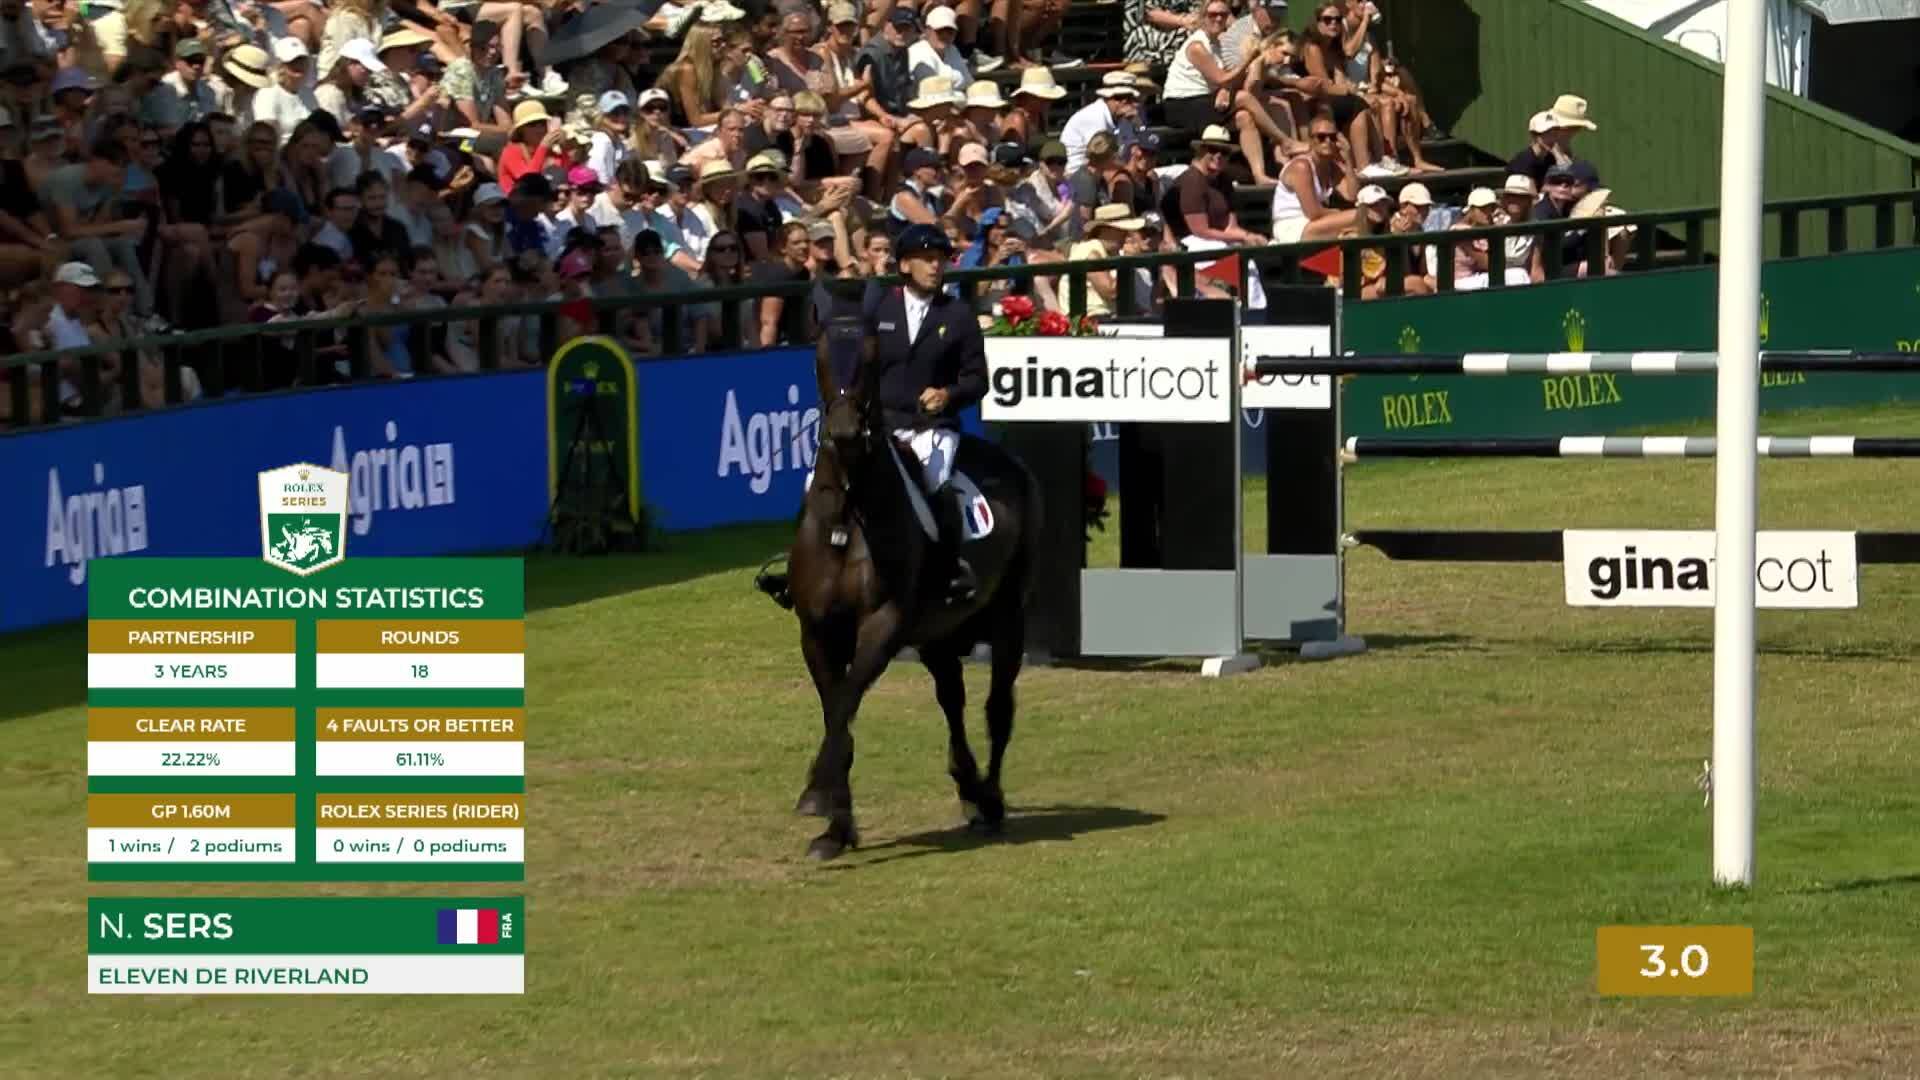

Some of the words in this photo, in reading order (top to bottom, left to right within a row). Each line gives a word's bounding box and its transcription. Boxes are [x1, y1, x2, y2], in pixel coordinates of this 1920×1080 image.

[992, 356, 1219, 408] ginatricot
[1543, 372, 1621, 411] ROLEX
[1382, 390, 1451, 429] ROLEX
[45, 462, 125, 585] Agria
[1588, 545, 1833, 600] ginacot
